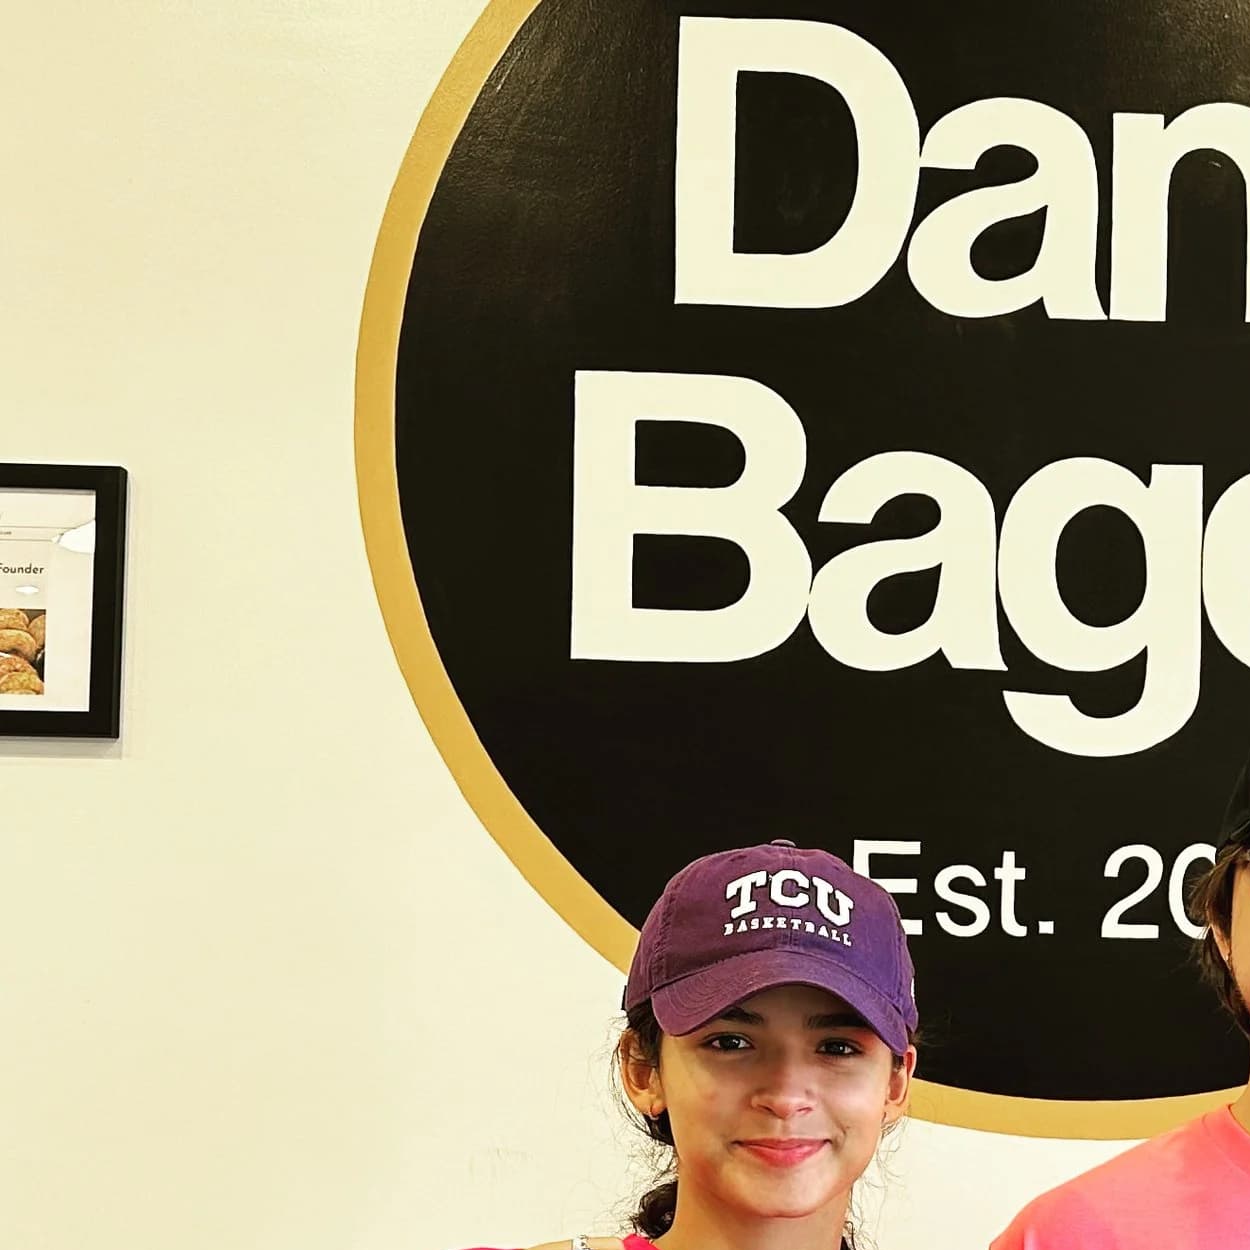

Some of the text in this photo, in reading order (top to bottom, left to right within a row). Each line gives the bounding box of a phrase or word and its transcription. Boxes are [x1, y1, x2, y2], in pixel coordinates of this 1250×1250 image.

[726, 869, 854, 927] TCU
[853, 839, 1054, 938] Est.
[724, 916, 852, 947] BASKETBALL
